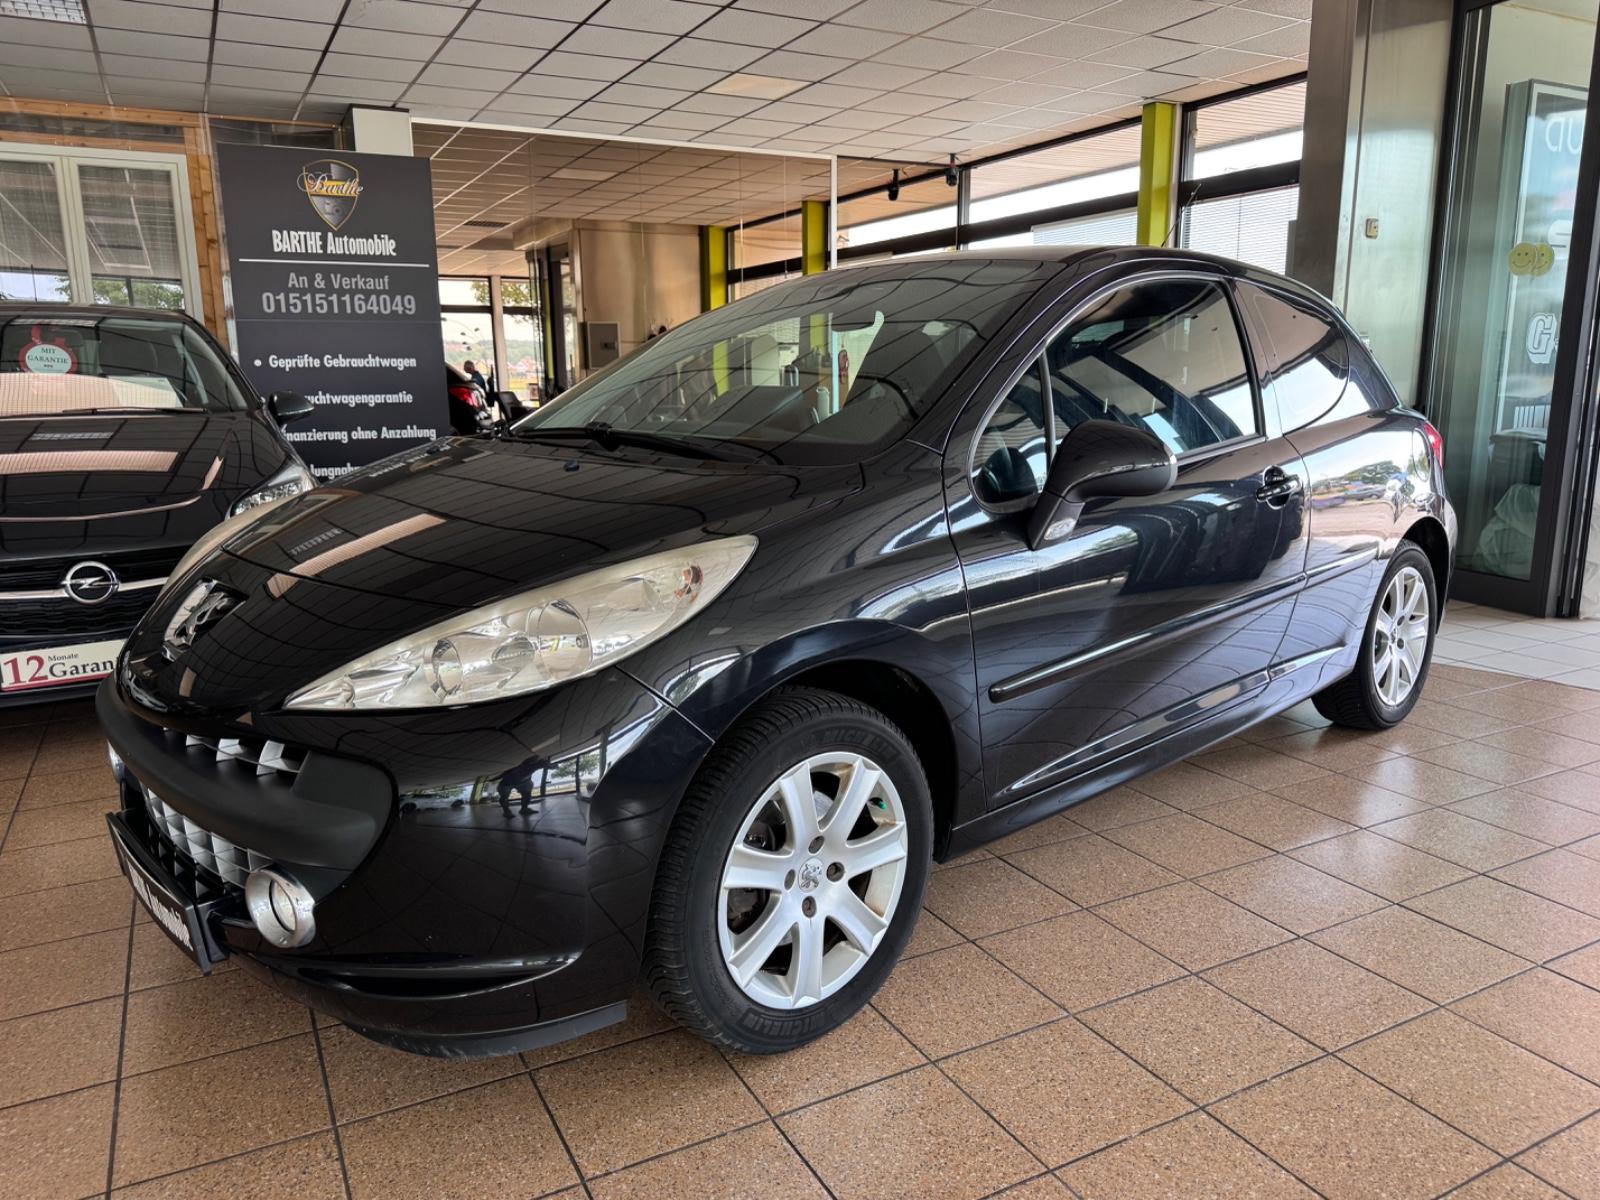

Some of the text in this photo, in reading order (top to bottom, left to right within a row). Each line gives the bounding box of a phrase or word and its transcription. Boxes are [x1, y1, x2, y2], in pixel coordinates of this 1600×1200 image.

[272, 229, 397, 256] BARTHE Automobile
[288, 272, 390, 290] An & Verkauf
[262, 292, 416, 315] 015151164049
[27, 354, 68, 364] GARANTIE
[268, 353, 417, 372] Geprüfte Gebrauchtwagen
[304, 390, 413, 407] uchtwagengarantie
[351, 425, 378, 440] ohne
[380, 424, 437, 441] Anzahlung
[3, 652, 79, 685] 12 Monate
